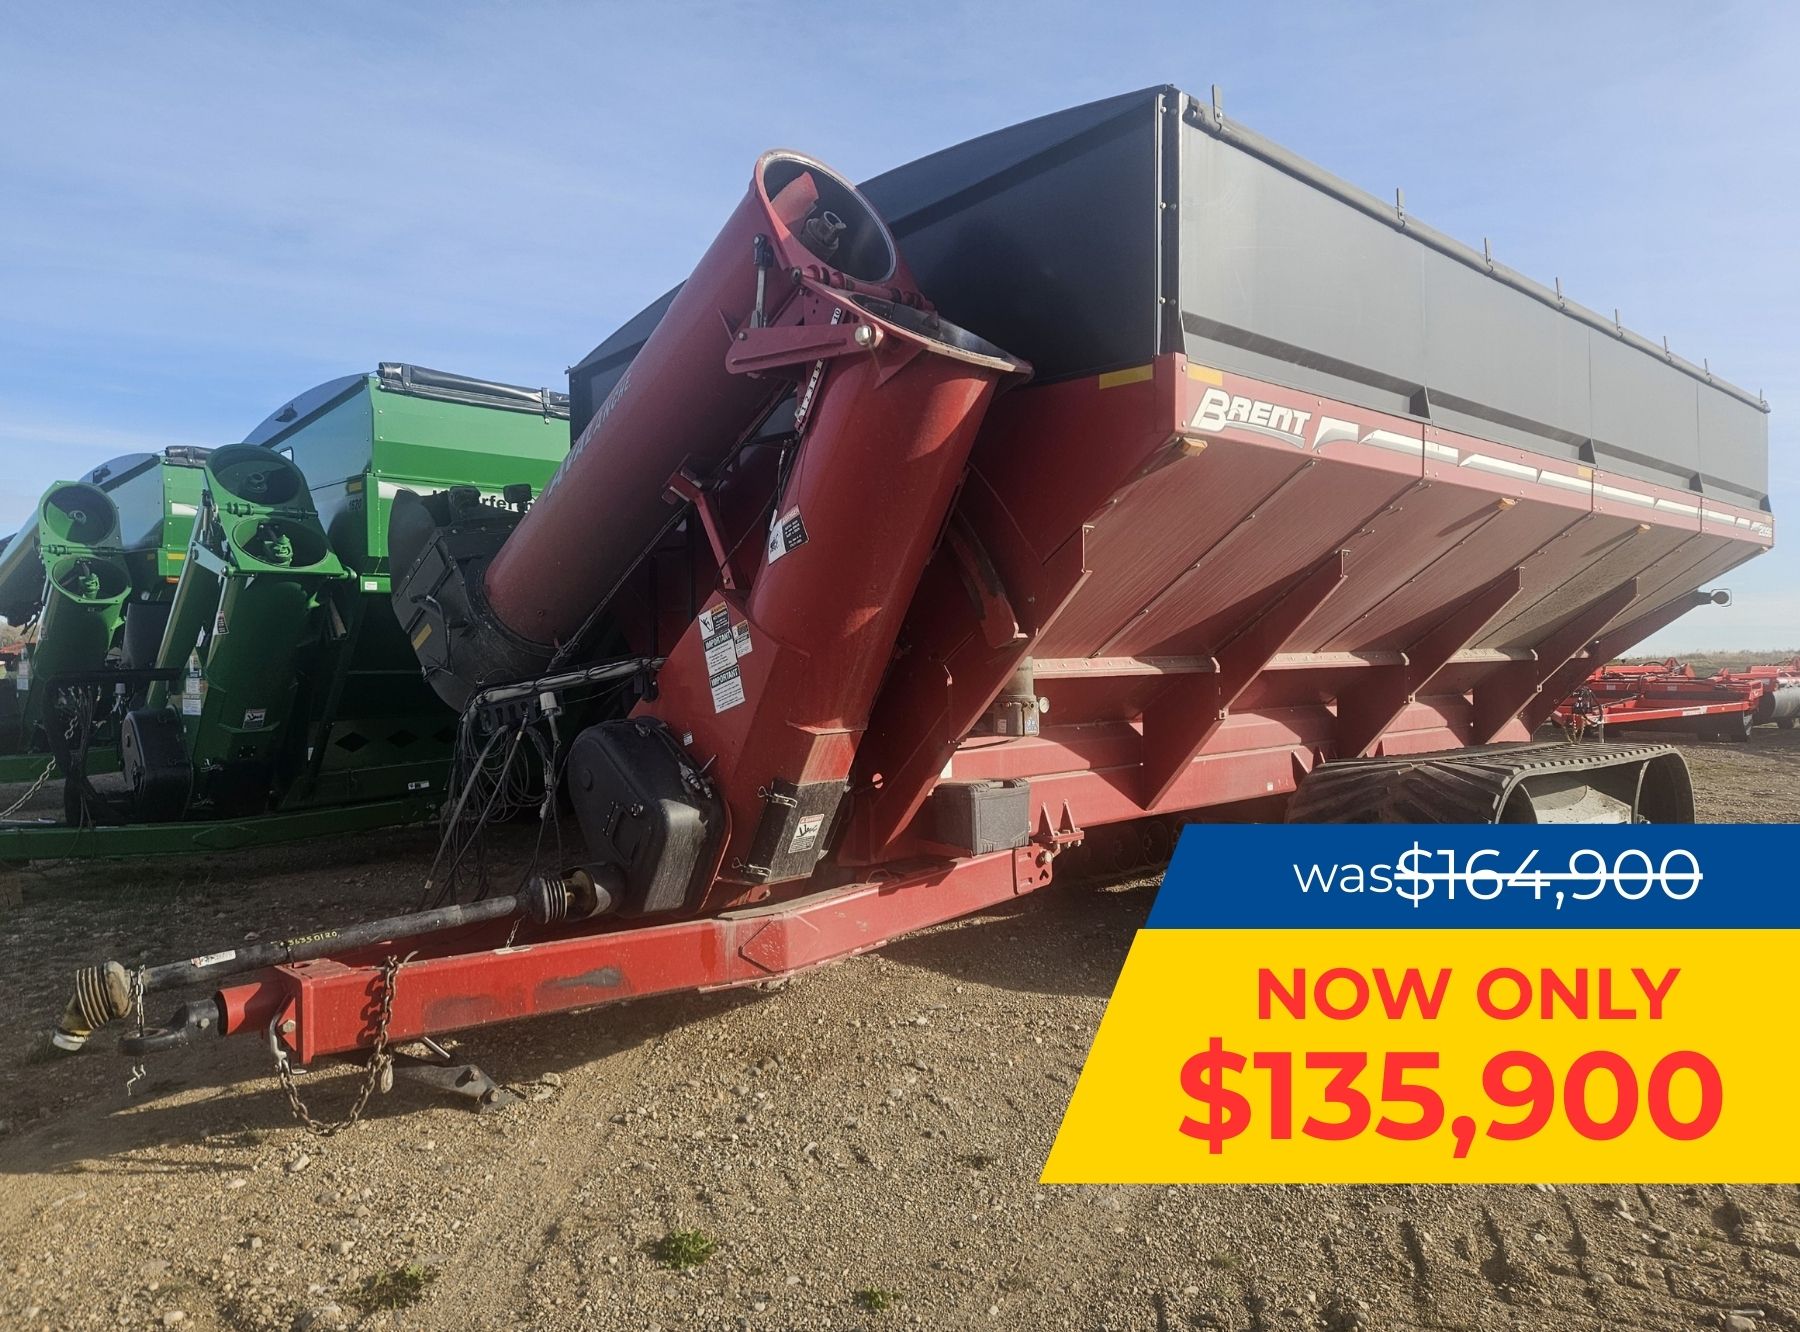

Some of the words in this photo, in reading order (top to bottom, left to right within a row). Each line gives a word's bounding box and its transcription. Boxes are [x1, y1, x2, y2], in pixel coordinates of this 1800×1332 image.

[1189, 387, 1312, 437] BRENT
[704, 631, 732, 651] IMPORTANT
[711, 668, 739, 688] IMPORTANT
